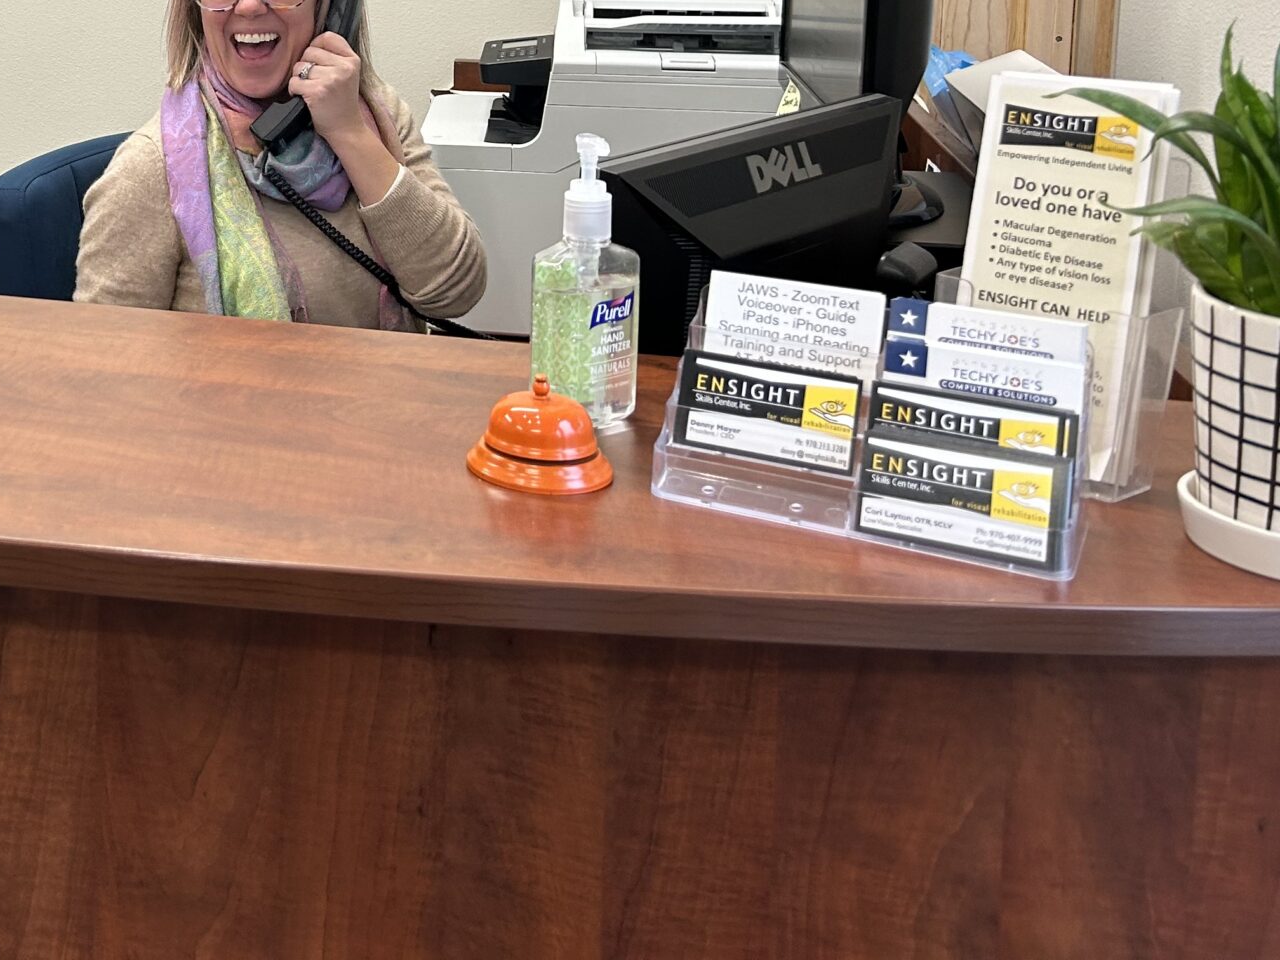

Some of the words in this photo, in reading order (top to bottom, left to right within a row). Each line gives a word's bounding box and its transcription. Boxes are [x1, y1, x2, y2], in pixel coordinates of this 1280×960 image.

[1006, 126, 1021, 135] Skills
[1008, 110, 1093, 132] ENSIGHT
[745, 140, 824, 195] DELL
[997, 149, 1050, 164] Empowering
[1052, 156, 1106, 170] Independent
[1108, 162, 1133, 175] Living
[1013, 176, 1036, 192] Do
[1041, 183, 1072, 197] you
[1077, 188, 1095, 200] or
[1098, 191, 1109, 204] a
[995, 191, 1043, 211] loved
[1046, 202, 1077, 216] one
[1082, 204, 1122, 223] have
[1000, 232, 1052, 248] Glaucoma
[1002, 219, 1045, 234] Macular
[1047, 226, 1117, 245] Degeneration
[999, 244, 1041, 259] Diabetic
[1044, 252, 1060, 264] Eye
[1064, 255, 1103, 270] Disease
[997, 258, 1017, 269] Any
[1020, 261, 1042, 274] type
[1045, 266, 1057, 274] of
[1058, 268, 1088, 281] vision
[1091, 273, 1111, 285] loss
[1008, 275, 1026, 284] eye
[1029, 276, 1074, 292] disease?
[738, 281, 779, 298] JAWS
[791, 290, 860, 311] ZoomText
[978, 290, 1038, 310] ENSIGHT
[1041, 302, 1070, 317] CAN
[1077, 308, 1110, 324] HELP
[596, 298, 631, 322] Purell
[737, 295, 803, 316] Voiceover
[816, 308, 856, 324] Guide
[743, 310, 779, 326] iPads
[792, 318, 847, 337] iPhones
[591, 340, 631, 357] SANITIZER
[600, 331, 624, 345] HAND
[719, 319, 780, 341] Scanning
[783, 332, 809, 341] and
[813, 335, 869, 357] Reading
[951, 326, 997, 341] TECHY
[999, 333, 1040, 348] JOE'S
[722, 334, 775, 356] Training
[778, 345, 804, 359] and
[808, 349, 861, 369] Support
[590, 358, 630, 375] NATURALS
[697, 373, 799, 406] ENSIGHT
[952, 368, 998, 384] TECHY
[1001, 376, 1042, 391] JOE'S
[695, 393, 713, 404] Skills
[714, 396, 739, 408] Center,
[739, 401, 752, 410] Inc.
[941, 380, 994, 395] COMPUTER
[997, 389, 1054, 405] SOLUTIONS
[767, 412, 777, 420] for
[780, 415, 800, 425] visual
[804, 420, 851, 433] rehabilitation
[881, 403, 994, 438] ENSIGHT
[871, 474, 890, 485] Skills
[892, 477, 920, 491] Center,
[920, 483, 935, 493] Inc.
[872, 453, 987, 489] ENSIGHT
[951, 498, 963, 506] for
[967, 501, 989, 512] visual
[993, 507, 1047, 522] rehabilitation
[933, 520, 953, 529] SCLV
